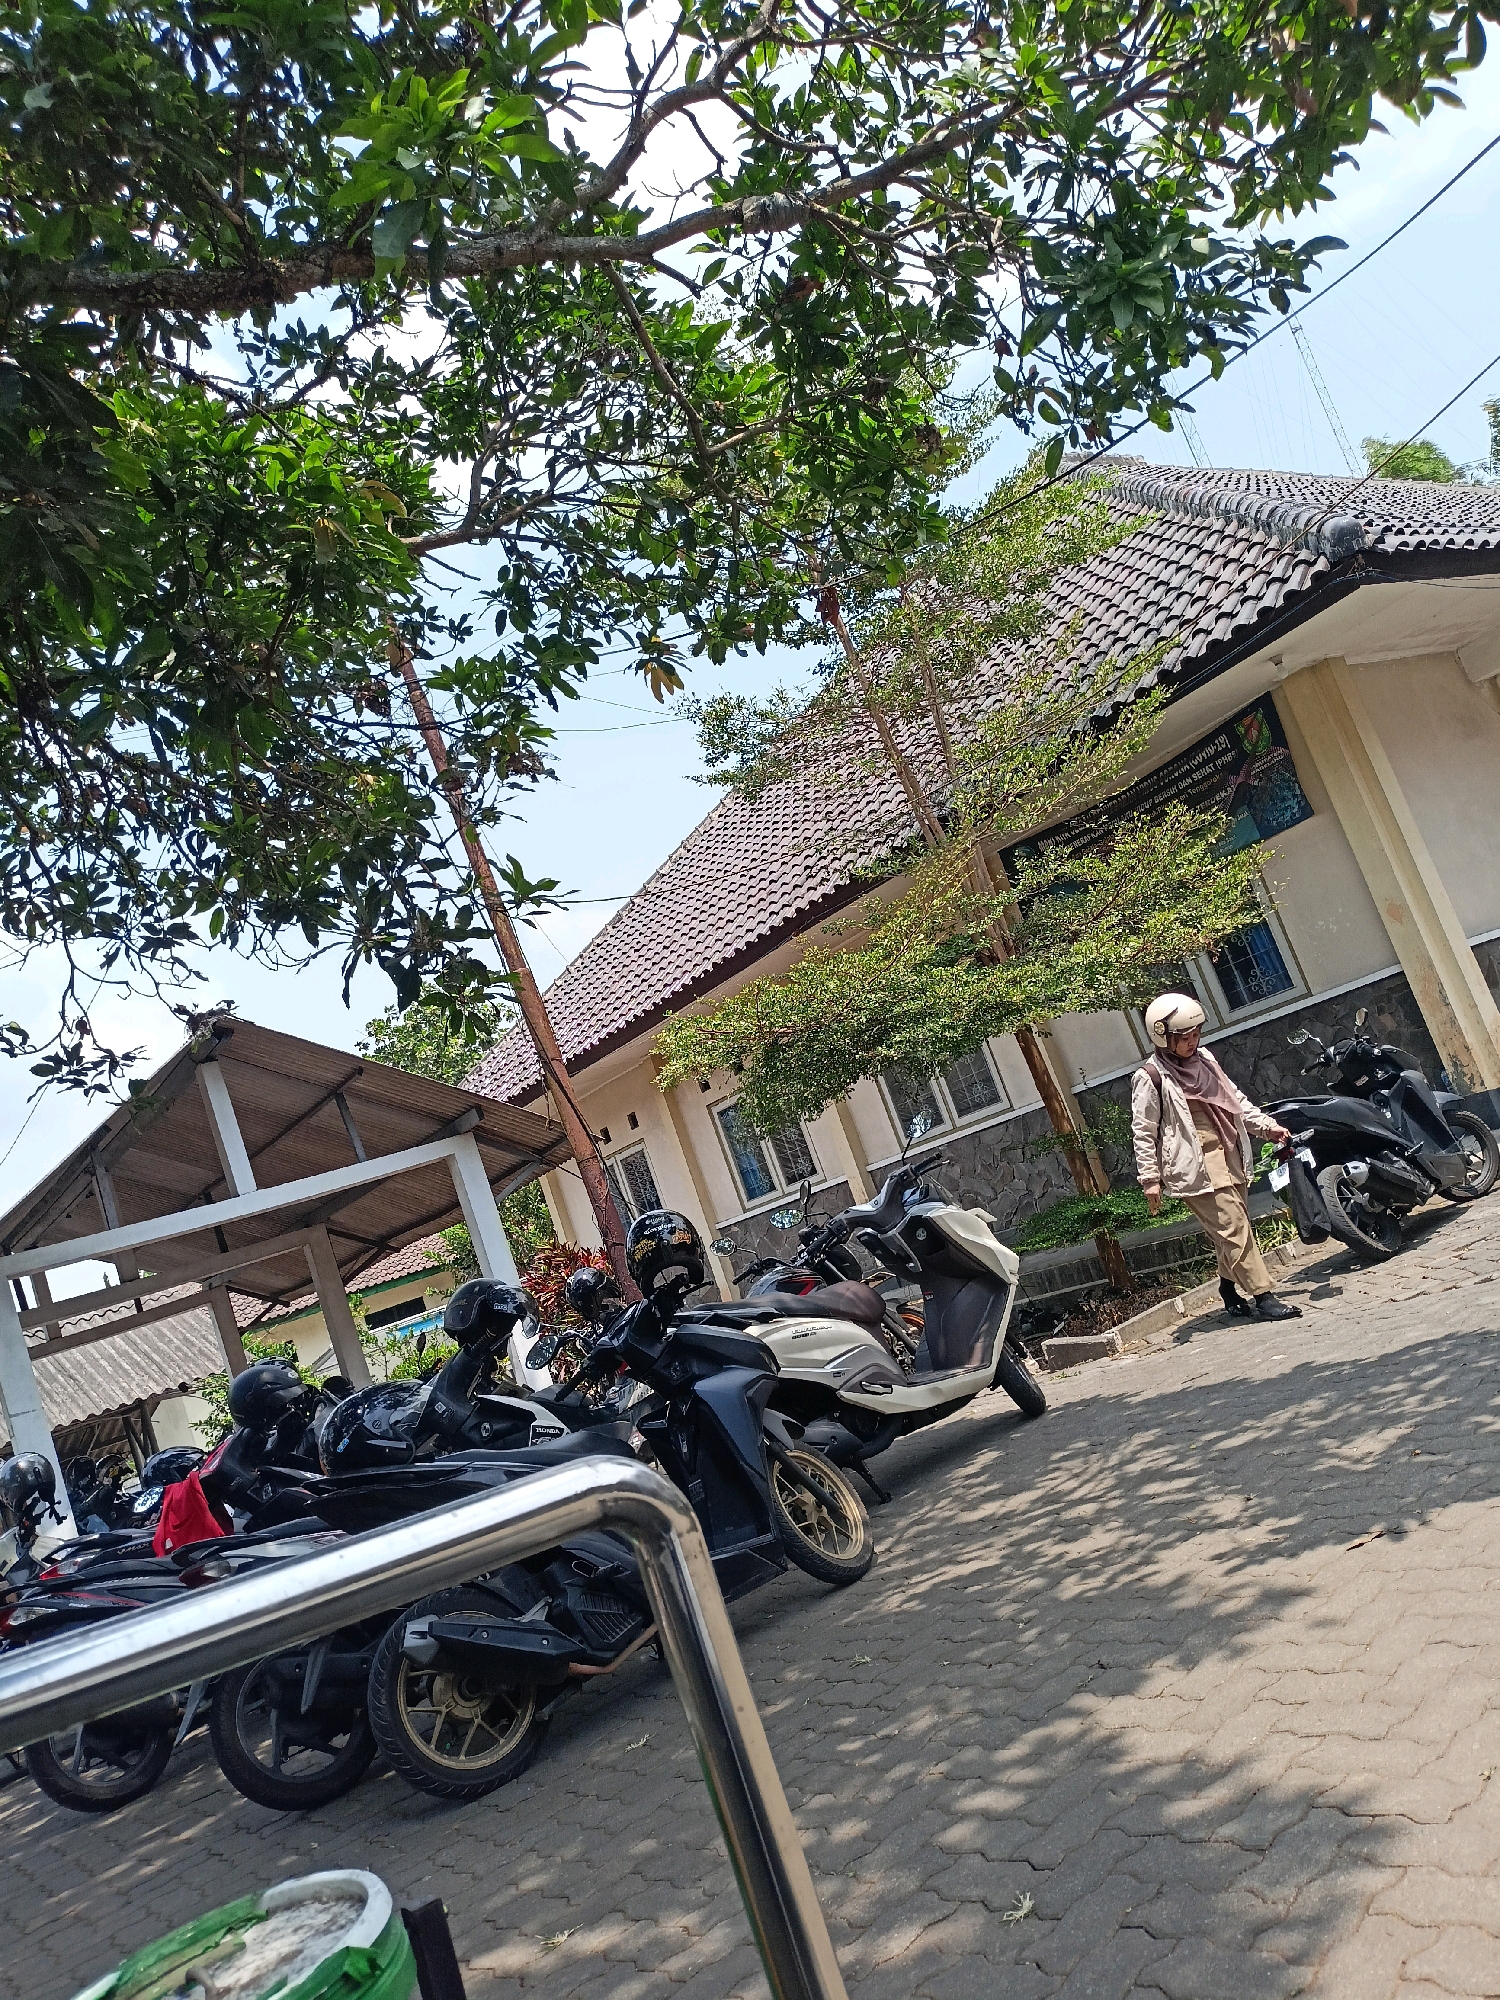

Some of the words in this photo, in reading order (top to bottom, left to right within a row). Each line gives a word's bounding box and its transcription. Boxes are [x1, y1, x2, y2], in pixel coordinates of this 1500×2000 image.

[1154, 784, 1179, 804] BERSIH
[1178, 776, 1194, 790] DAN
[1192, 763, 1216, 781] SEHAT
